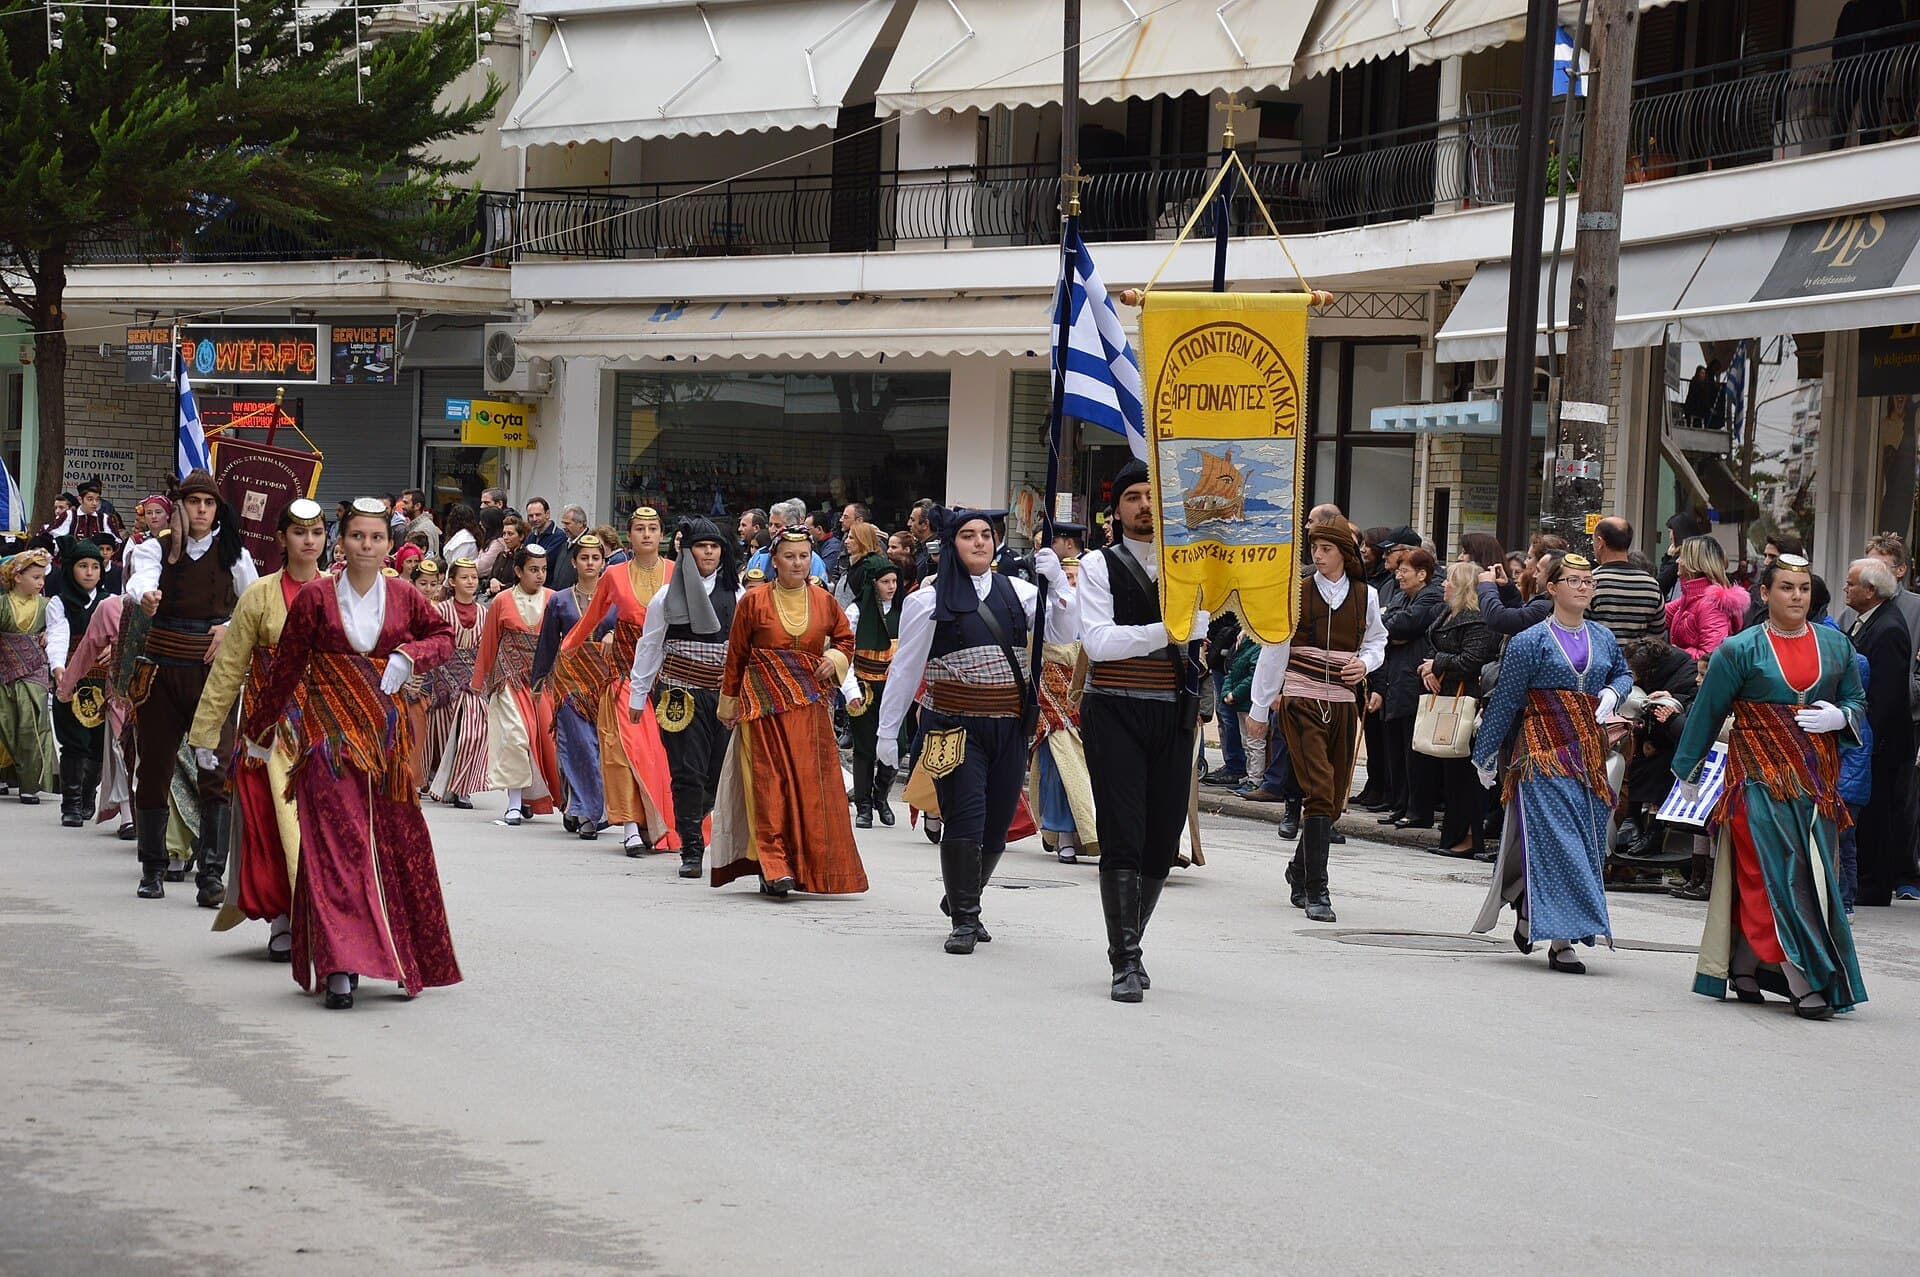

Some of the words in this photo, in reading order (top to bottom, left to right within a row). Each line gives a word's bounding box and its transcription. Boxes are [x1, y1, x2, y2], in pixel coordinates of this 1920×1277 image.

[1811, 212, 1886, 267] DLS
[127, 329, 169, 344] SERVICE
[333, 328, 378, 343] SERVICE
[380, 328, 394, 343] PC
[1178, 331, 1254, 367] ΠΟΝΤΙΩΝ
[1172, 383, 1267, 411] ΑΡΓΟΝΑΥΤΕΣ
[493, 413, 523, 429] cyta
[503, 432, 522, 441] spot
[64, 448, 89, 457] ΩΡΓΙΟΣ
[92, 449, 134, 460] ΣΤΕΦΑΝΙΔΗΣ
[68, 460, 126, 471] ΧΕΙΡΟΥΡΓΟΣ
[64, 471, 134, 483] ΦΘΑΛΜΙΑΤΡΟΣ
[1241, 547, 1277, 563] 1970
